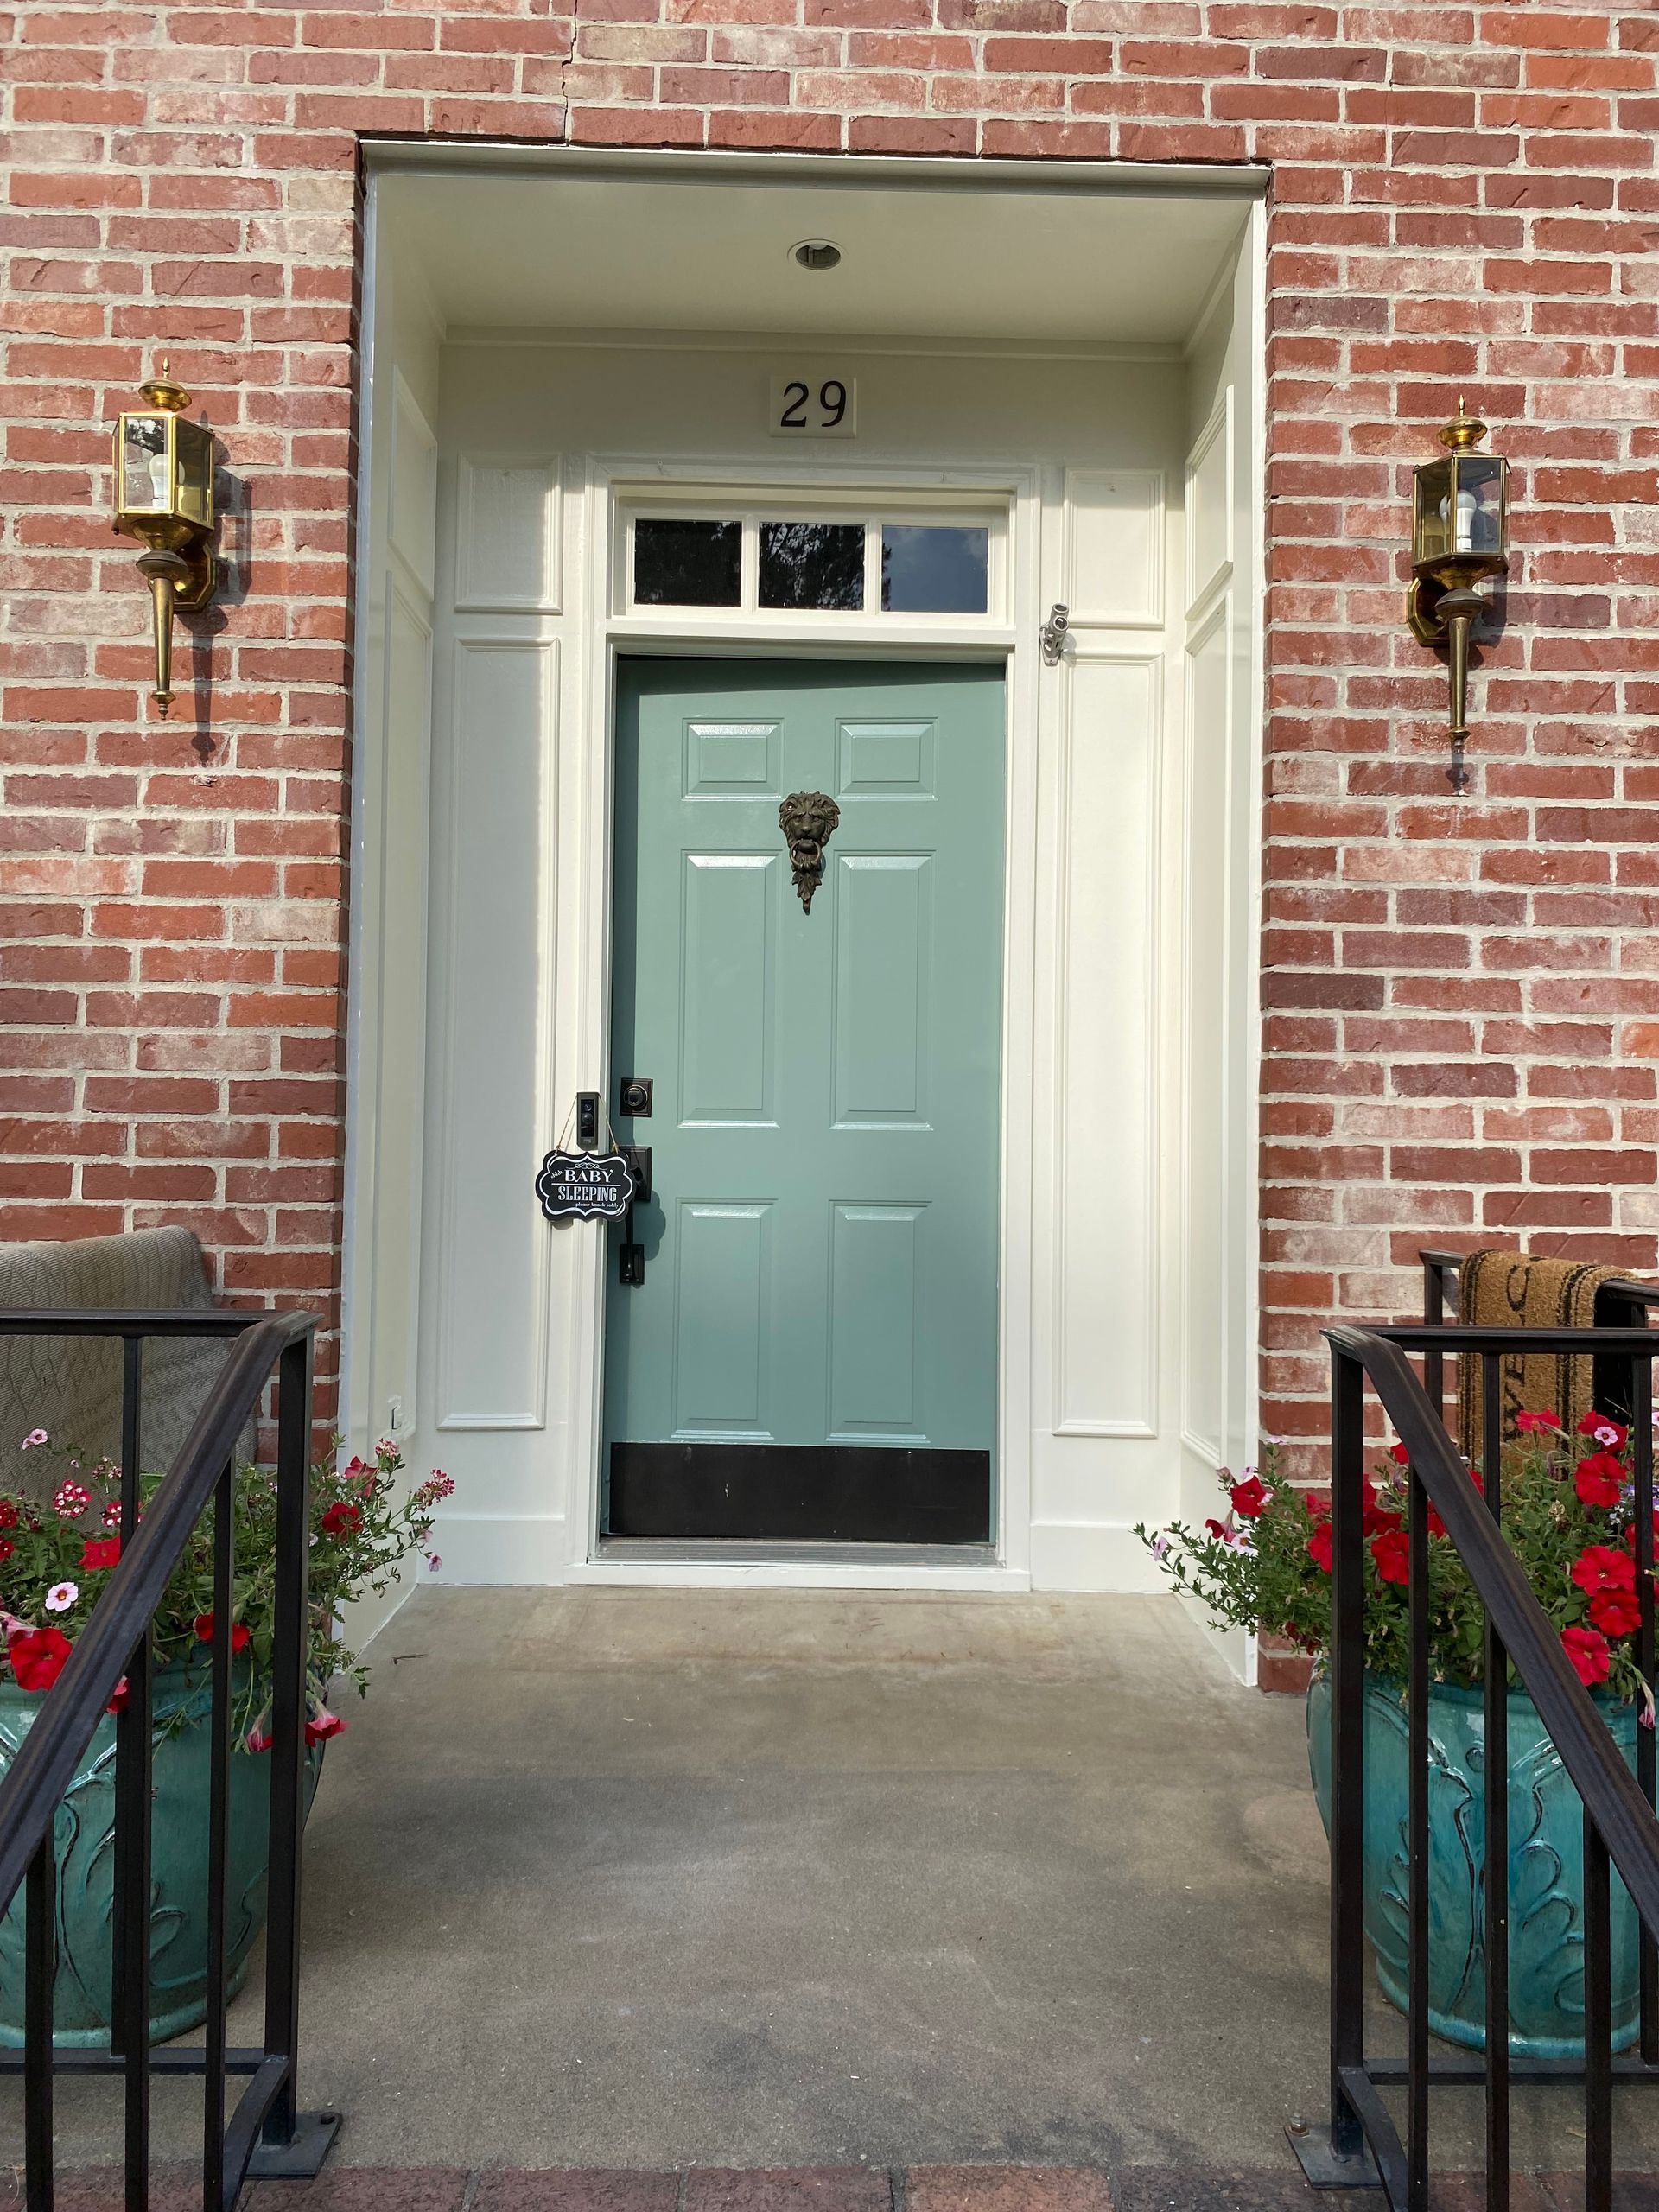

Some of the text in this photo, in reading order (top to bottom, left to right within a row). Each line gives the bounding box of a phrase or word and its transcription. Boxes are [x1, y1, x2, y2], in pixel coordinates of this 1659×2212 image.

[781, 380, 847, 428] 29
[564, 1169, 613, 1183] BABY
[557, 1185, 617, 1202] SLEEPING
